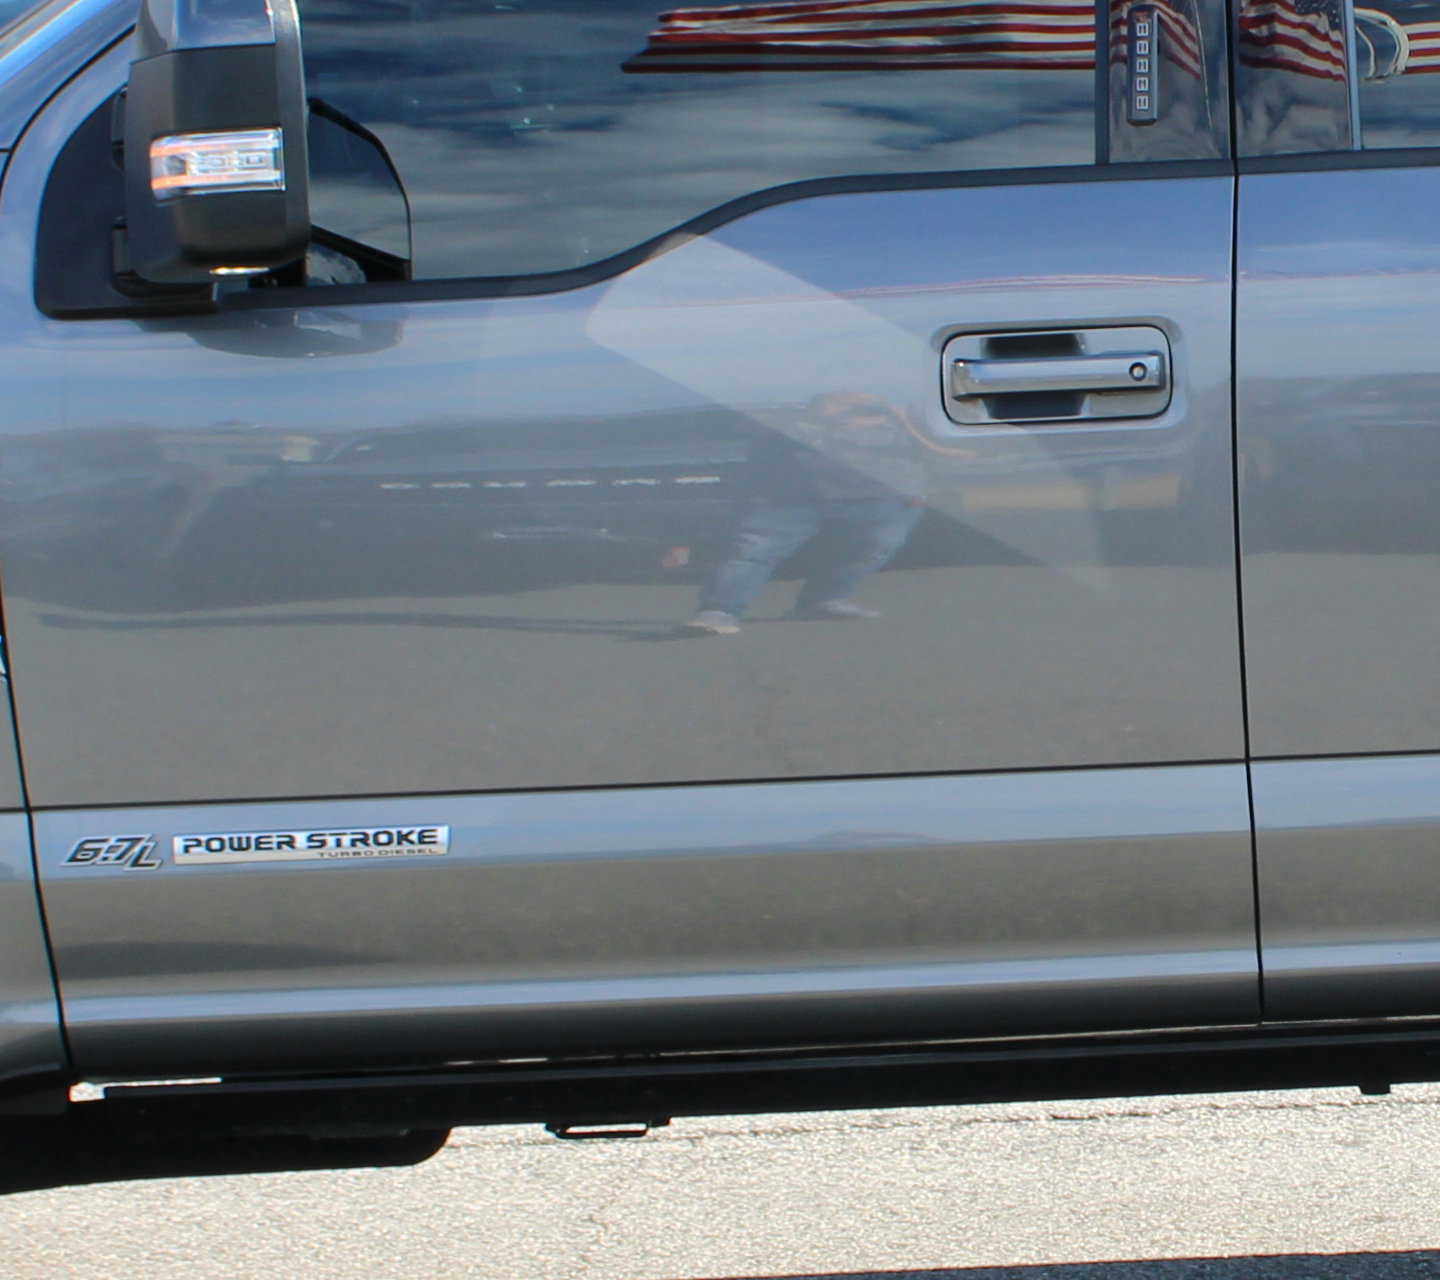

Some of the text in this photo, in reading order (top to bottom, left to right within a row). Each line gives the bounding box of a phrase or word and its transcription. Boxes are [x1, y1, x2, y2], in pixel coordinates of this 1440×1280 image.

[61, 833, 162, 871] 6.7L
[182, 827, 439, 855] POWER STROKE
[316, 847, 439, 858] TURBO DIESEL
